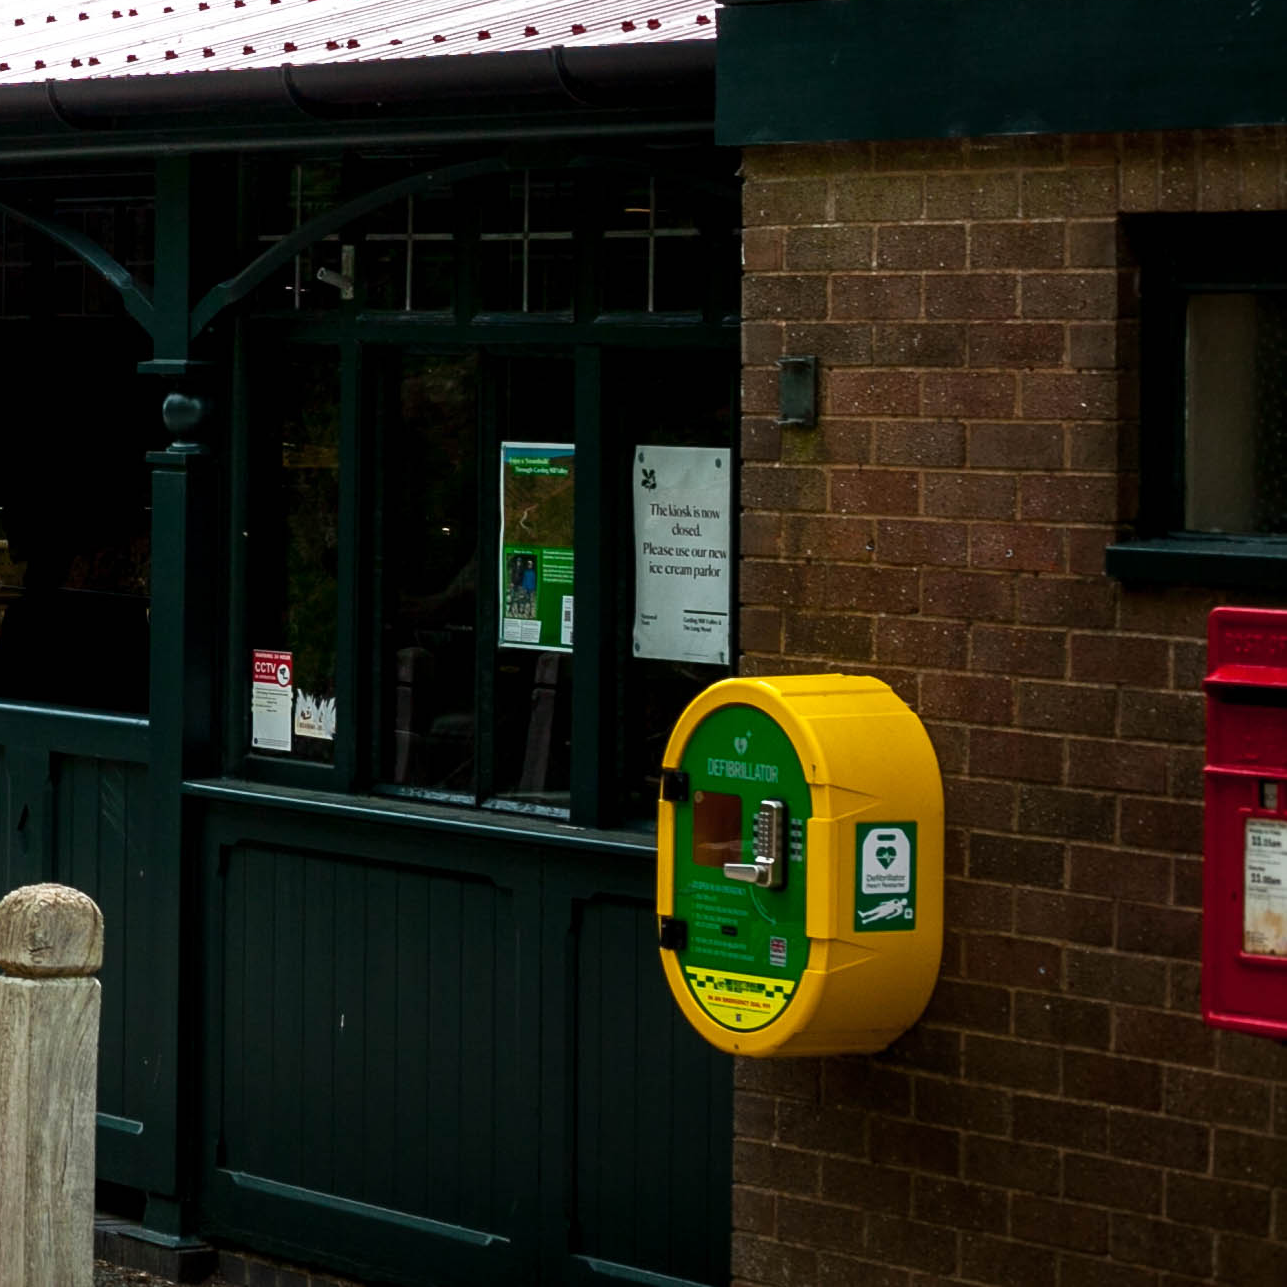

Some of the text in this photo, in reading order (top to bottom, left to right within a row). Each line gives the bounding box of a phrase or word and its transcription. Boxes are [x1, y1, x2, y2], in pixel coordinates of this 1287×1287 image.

[650, 503, 720, 519] The kiosk is now
[671, 523, 702, 537] closed.
[643, 542, 727, 559] Please use our new
[649, 561, 721, 579] ice cream parlor
[255, 662, 277, 673] CCTV
[707, 757, 779, 784] DEFIBRILLATOR
